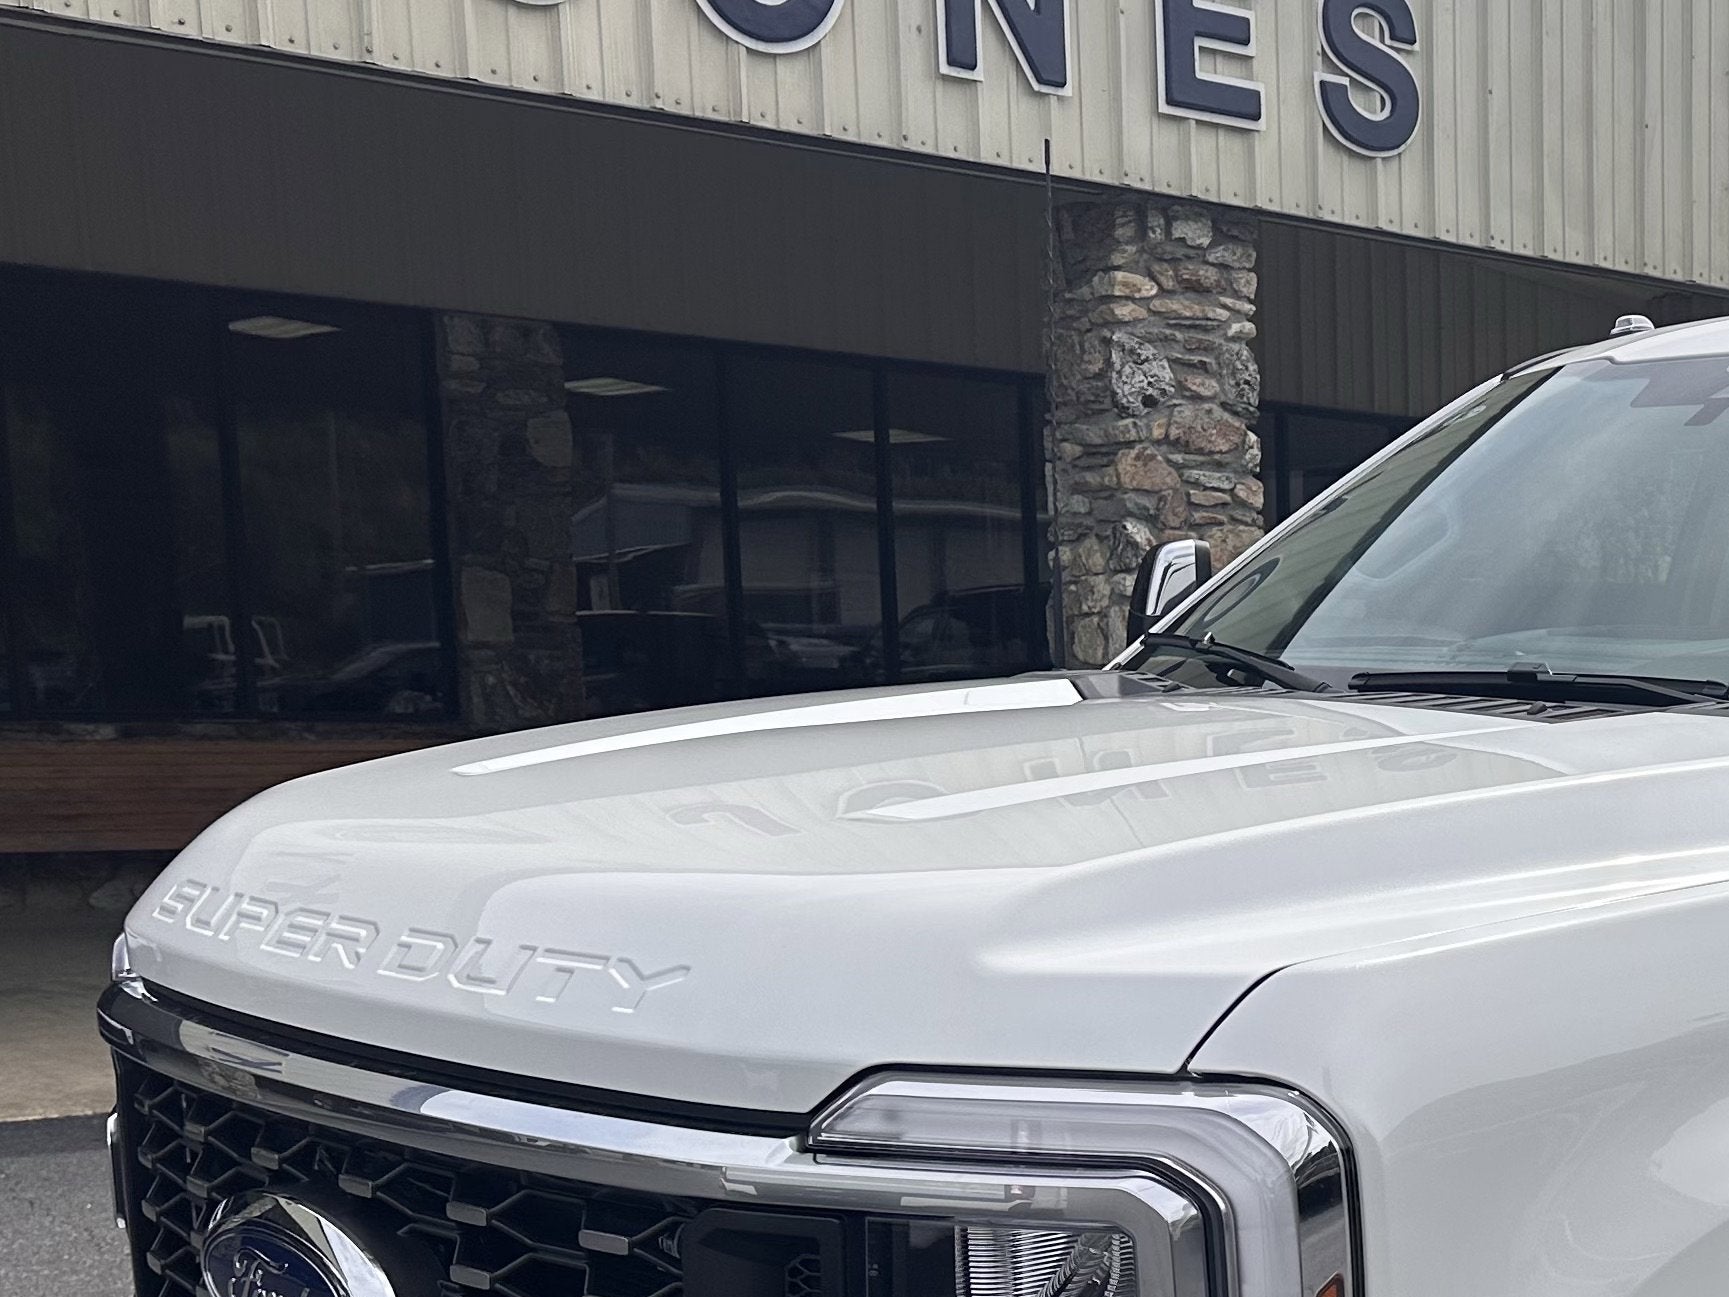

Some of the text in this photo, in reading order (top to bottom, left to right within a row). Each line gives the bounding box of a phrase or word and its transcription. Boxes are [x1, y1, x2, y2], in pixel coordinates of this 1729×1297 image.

[696, 0, 1421, 157] NES
[152, 877, 692, 1013] SUPER DUTY
